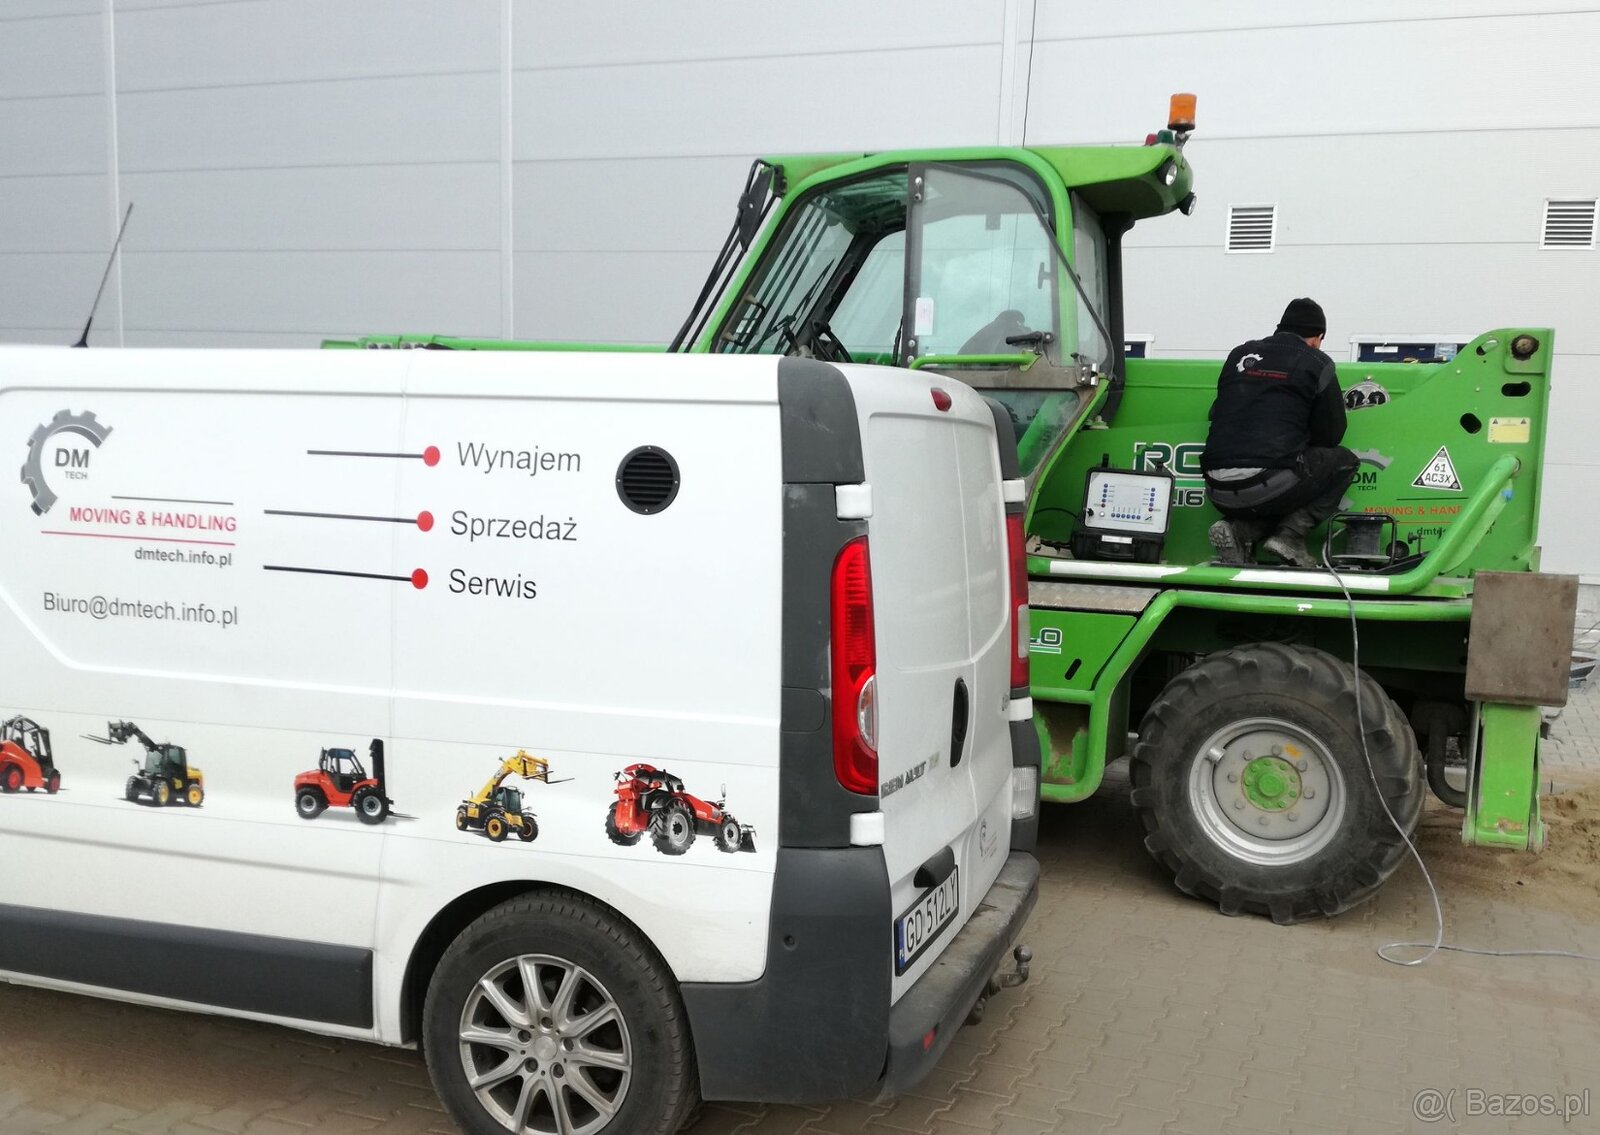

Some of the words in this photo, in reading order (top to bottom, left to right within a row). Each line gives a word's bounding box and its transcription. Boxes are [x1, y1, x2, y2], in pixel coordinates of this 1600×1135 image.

[55, 448, 90, 469] DM
[457, 441, 581, 477] Wynajem
[1133, 442, 1207, 477] RO
[1433, 463, 1446, 473] 61
[64, 470, 88, 480] TECH
[1425, 472, 1451, 484] AC3X
[69, 506, 131, 525] MOVING
[136, 511, 147, 526] &
[151, 512, 237, 532] HANDLING
[1363, 505, 1414, 515] MOVING
[450, 510, 578, 543] Sprzedaż
[134, 546, 232, 569] dmtech.info.pl
[448, 568, 537, 600] Serwis
[43, 592, 239, 628] Biuro@dmtech.info.pl
[906, 909, 923, 953] GD
[926, 873, 956, 934] 512LY
